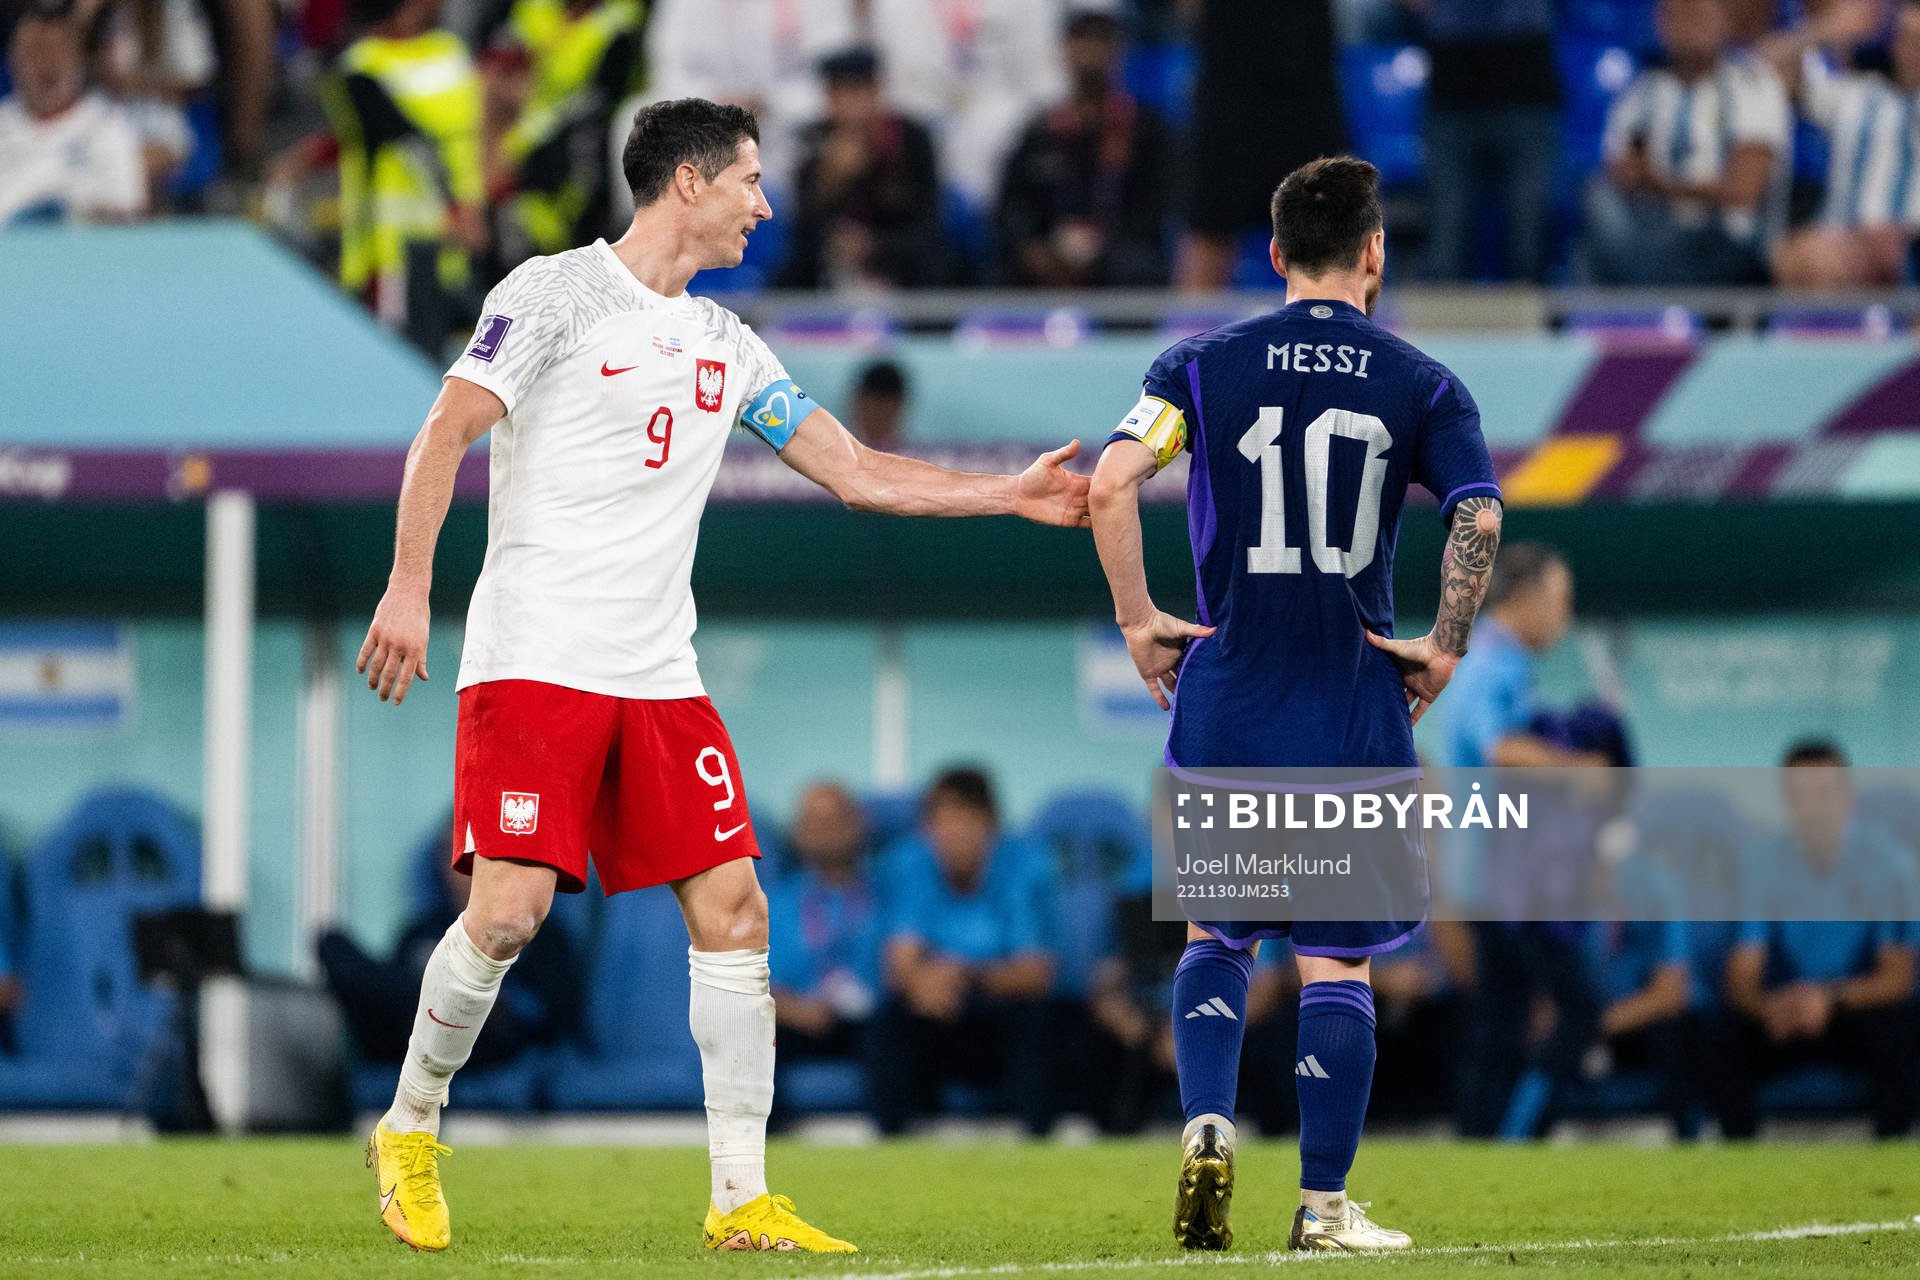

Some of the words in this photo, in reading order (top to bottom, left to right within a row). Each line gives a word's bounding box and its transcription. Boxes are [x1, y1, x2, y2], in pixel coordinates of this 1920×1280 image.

[1267, 343, 1372, 378] MESSI
[644, 405, 674, 470] 9
[1236, 406, 1394, 579] 10
[694, 745, 735, 812] 9
